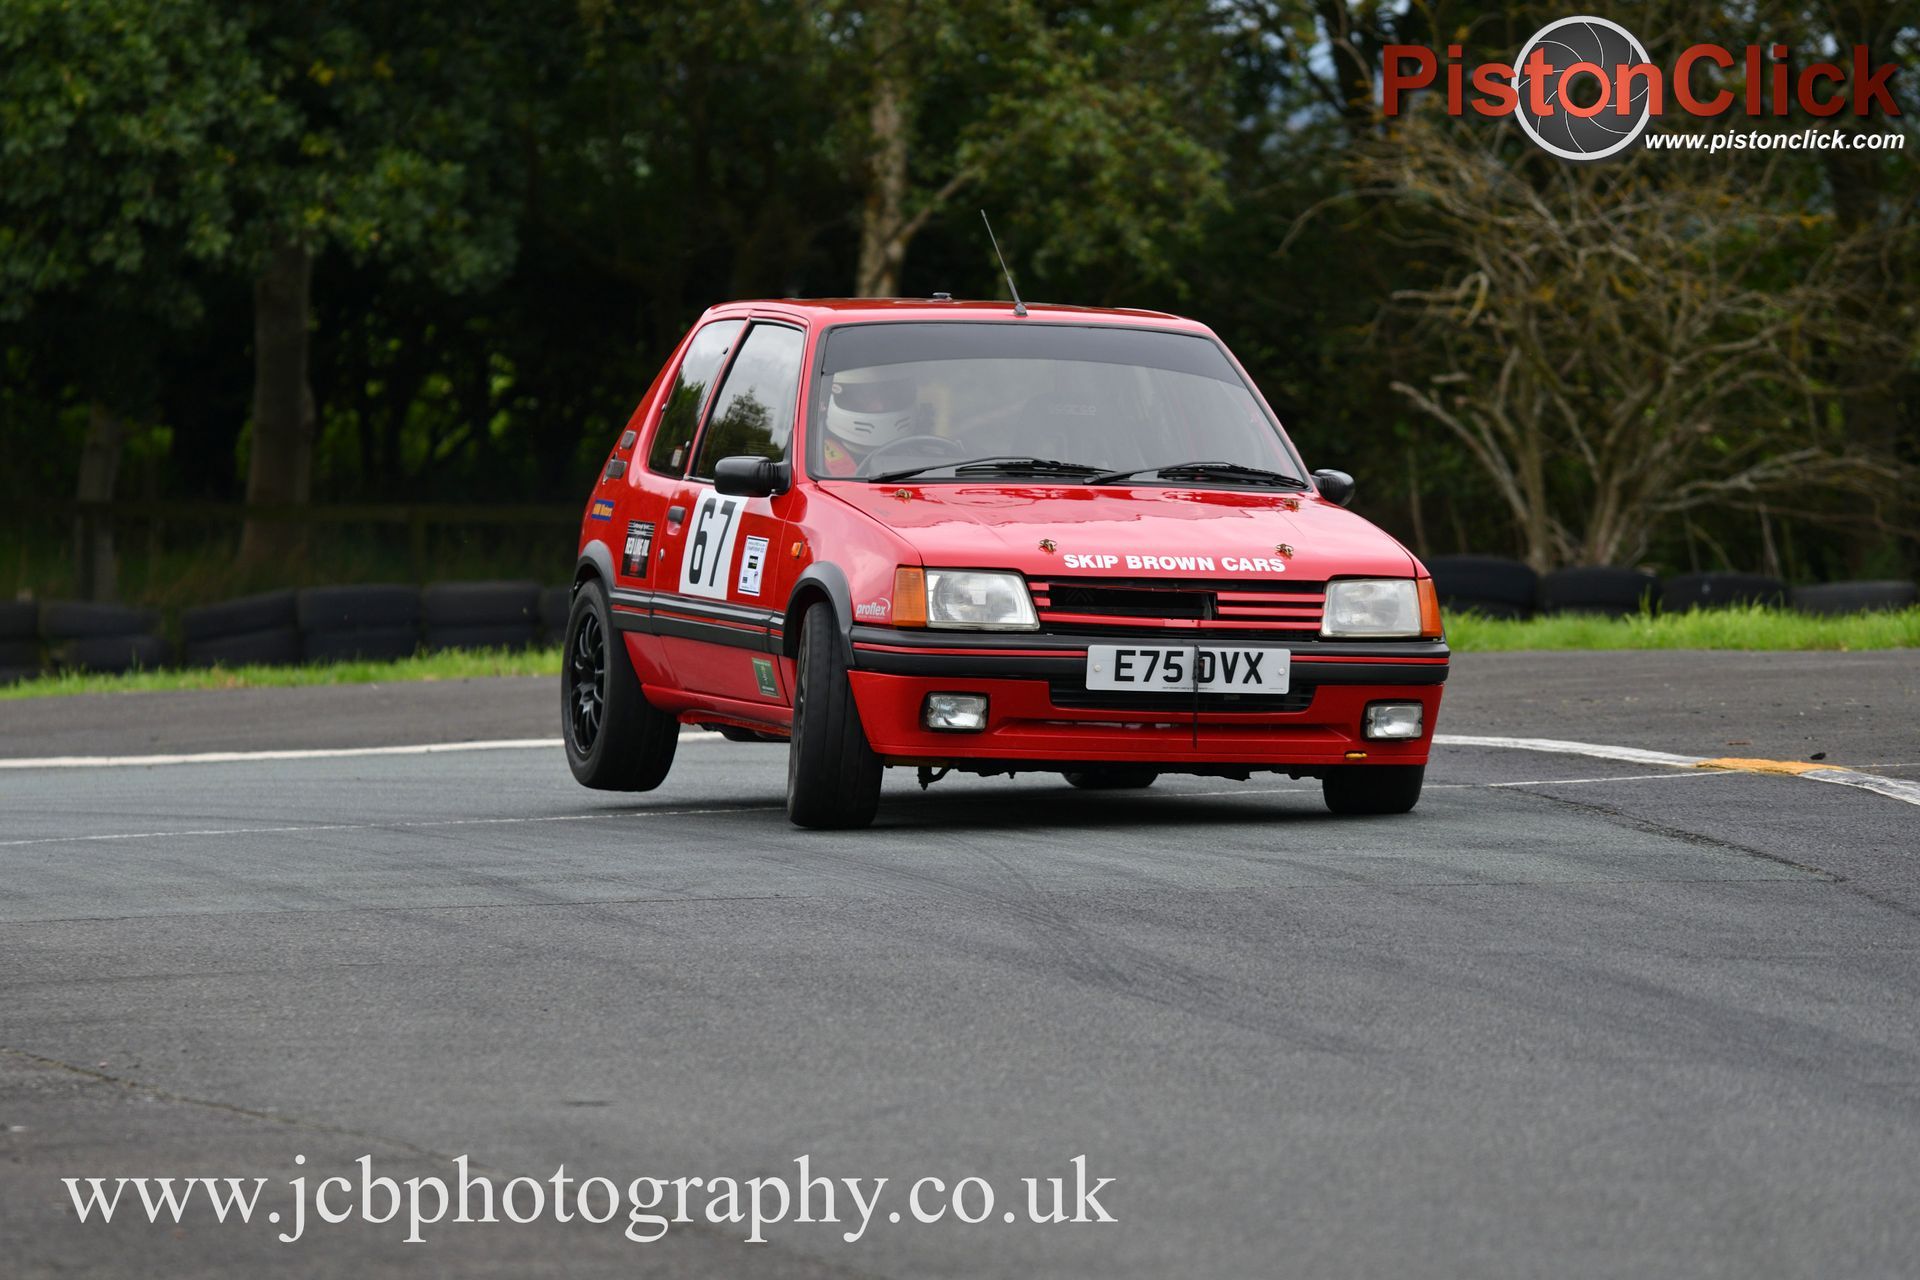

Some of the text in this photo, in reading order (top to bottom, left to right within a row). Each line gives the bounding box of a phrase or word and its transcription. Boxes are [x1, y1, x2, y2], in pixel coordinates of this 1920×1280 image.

[689, 498, 737, 587] 67
[1063, 554, 1286, 572] SKIP BROWN CARS
[856, 601, 886, 618] proflex
[1114, 649, 1265, 684] E75 DVX
